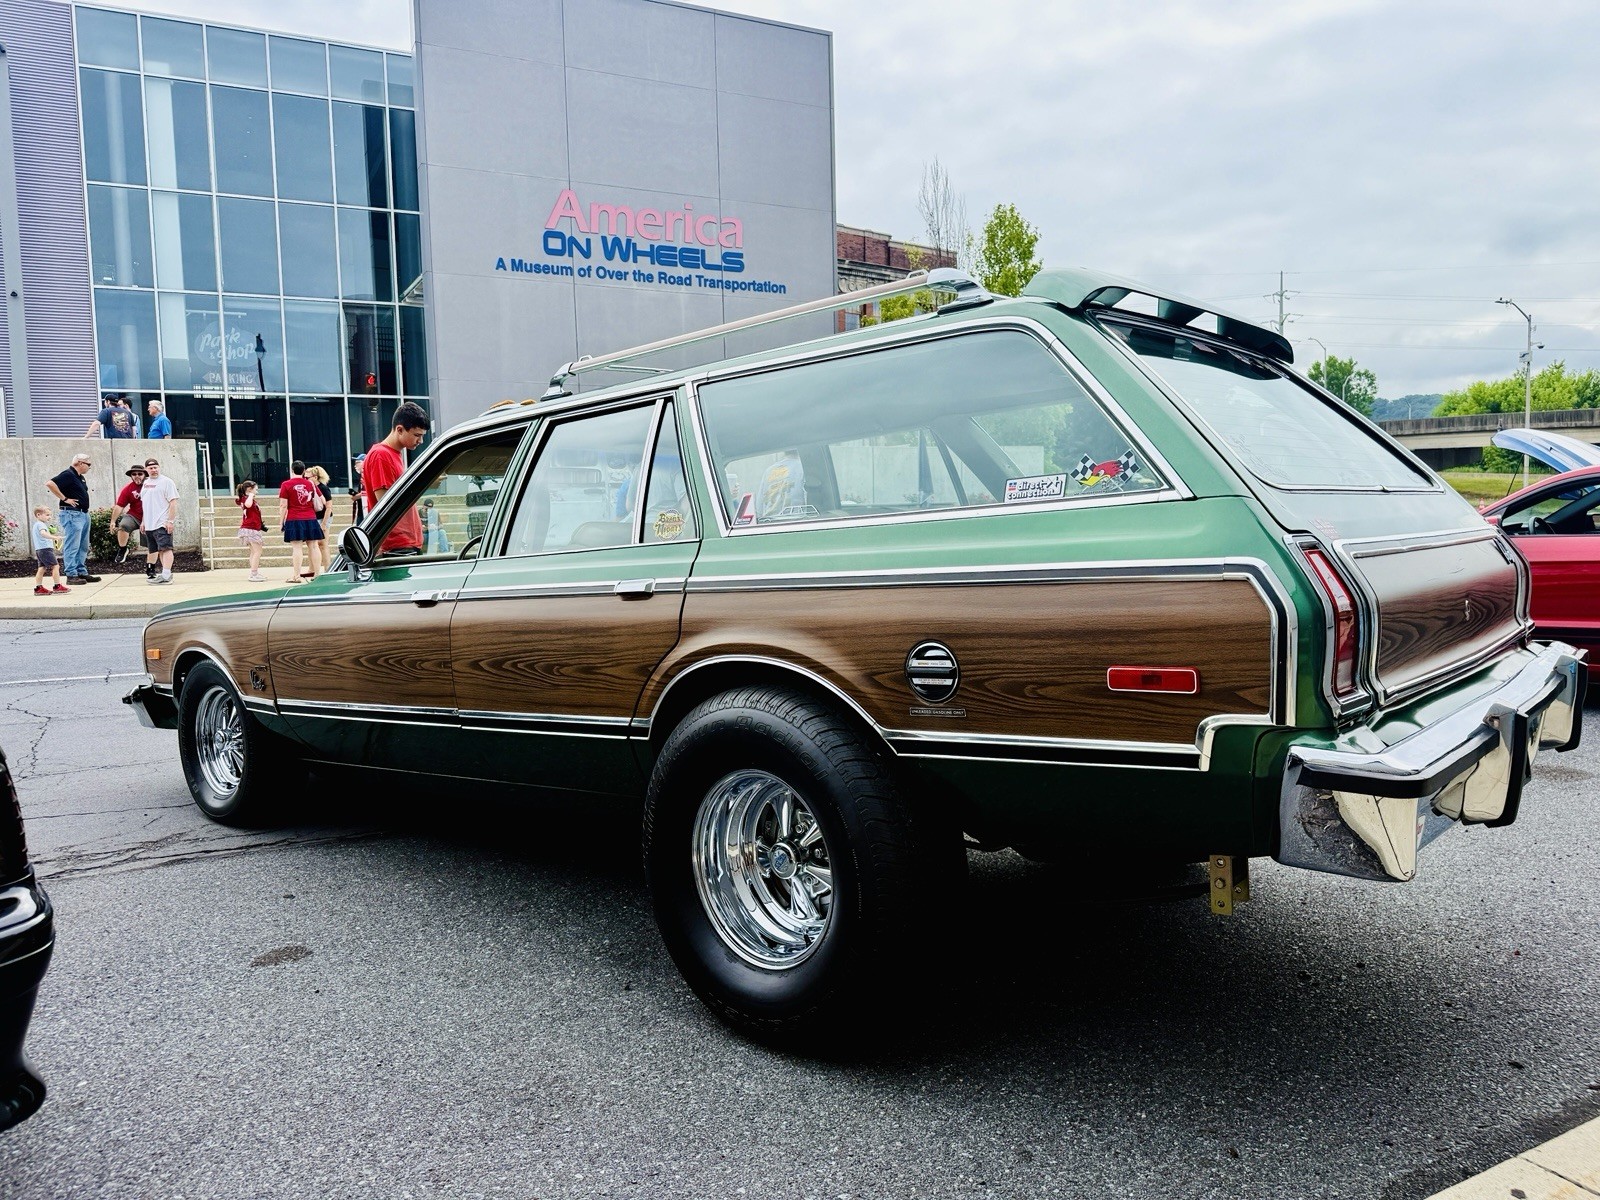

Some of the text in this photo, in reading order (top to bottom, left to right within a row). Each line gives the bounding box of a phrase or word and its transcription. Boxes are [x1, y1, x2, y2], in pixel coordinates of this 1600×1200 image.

[544, 188, 744, 249] America
[543, 230, 591, 259] ON
[495, 257, 787, 295] A Museum of Over the Road Transportation
[208, 372, 254, 384] PAKING
[1007, 488, 1055, 499] connection
[734, 716, 829, 782] Radial
